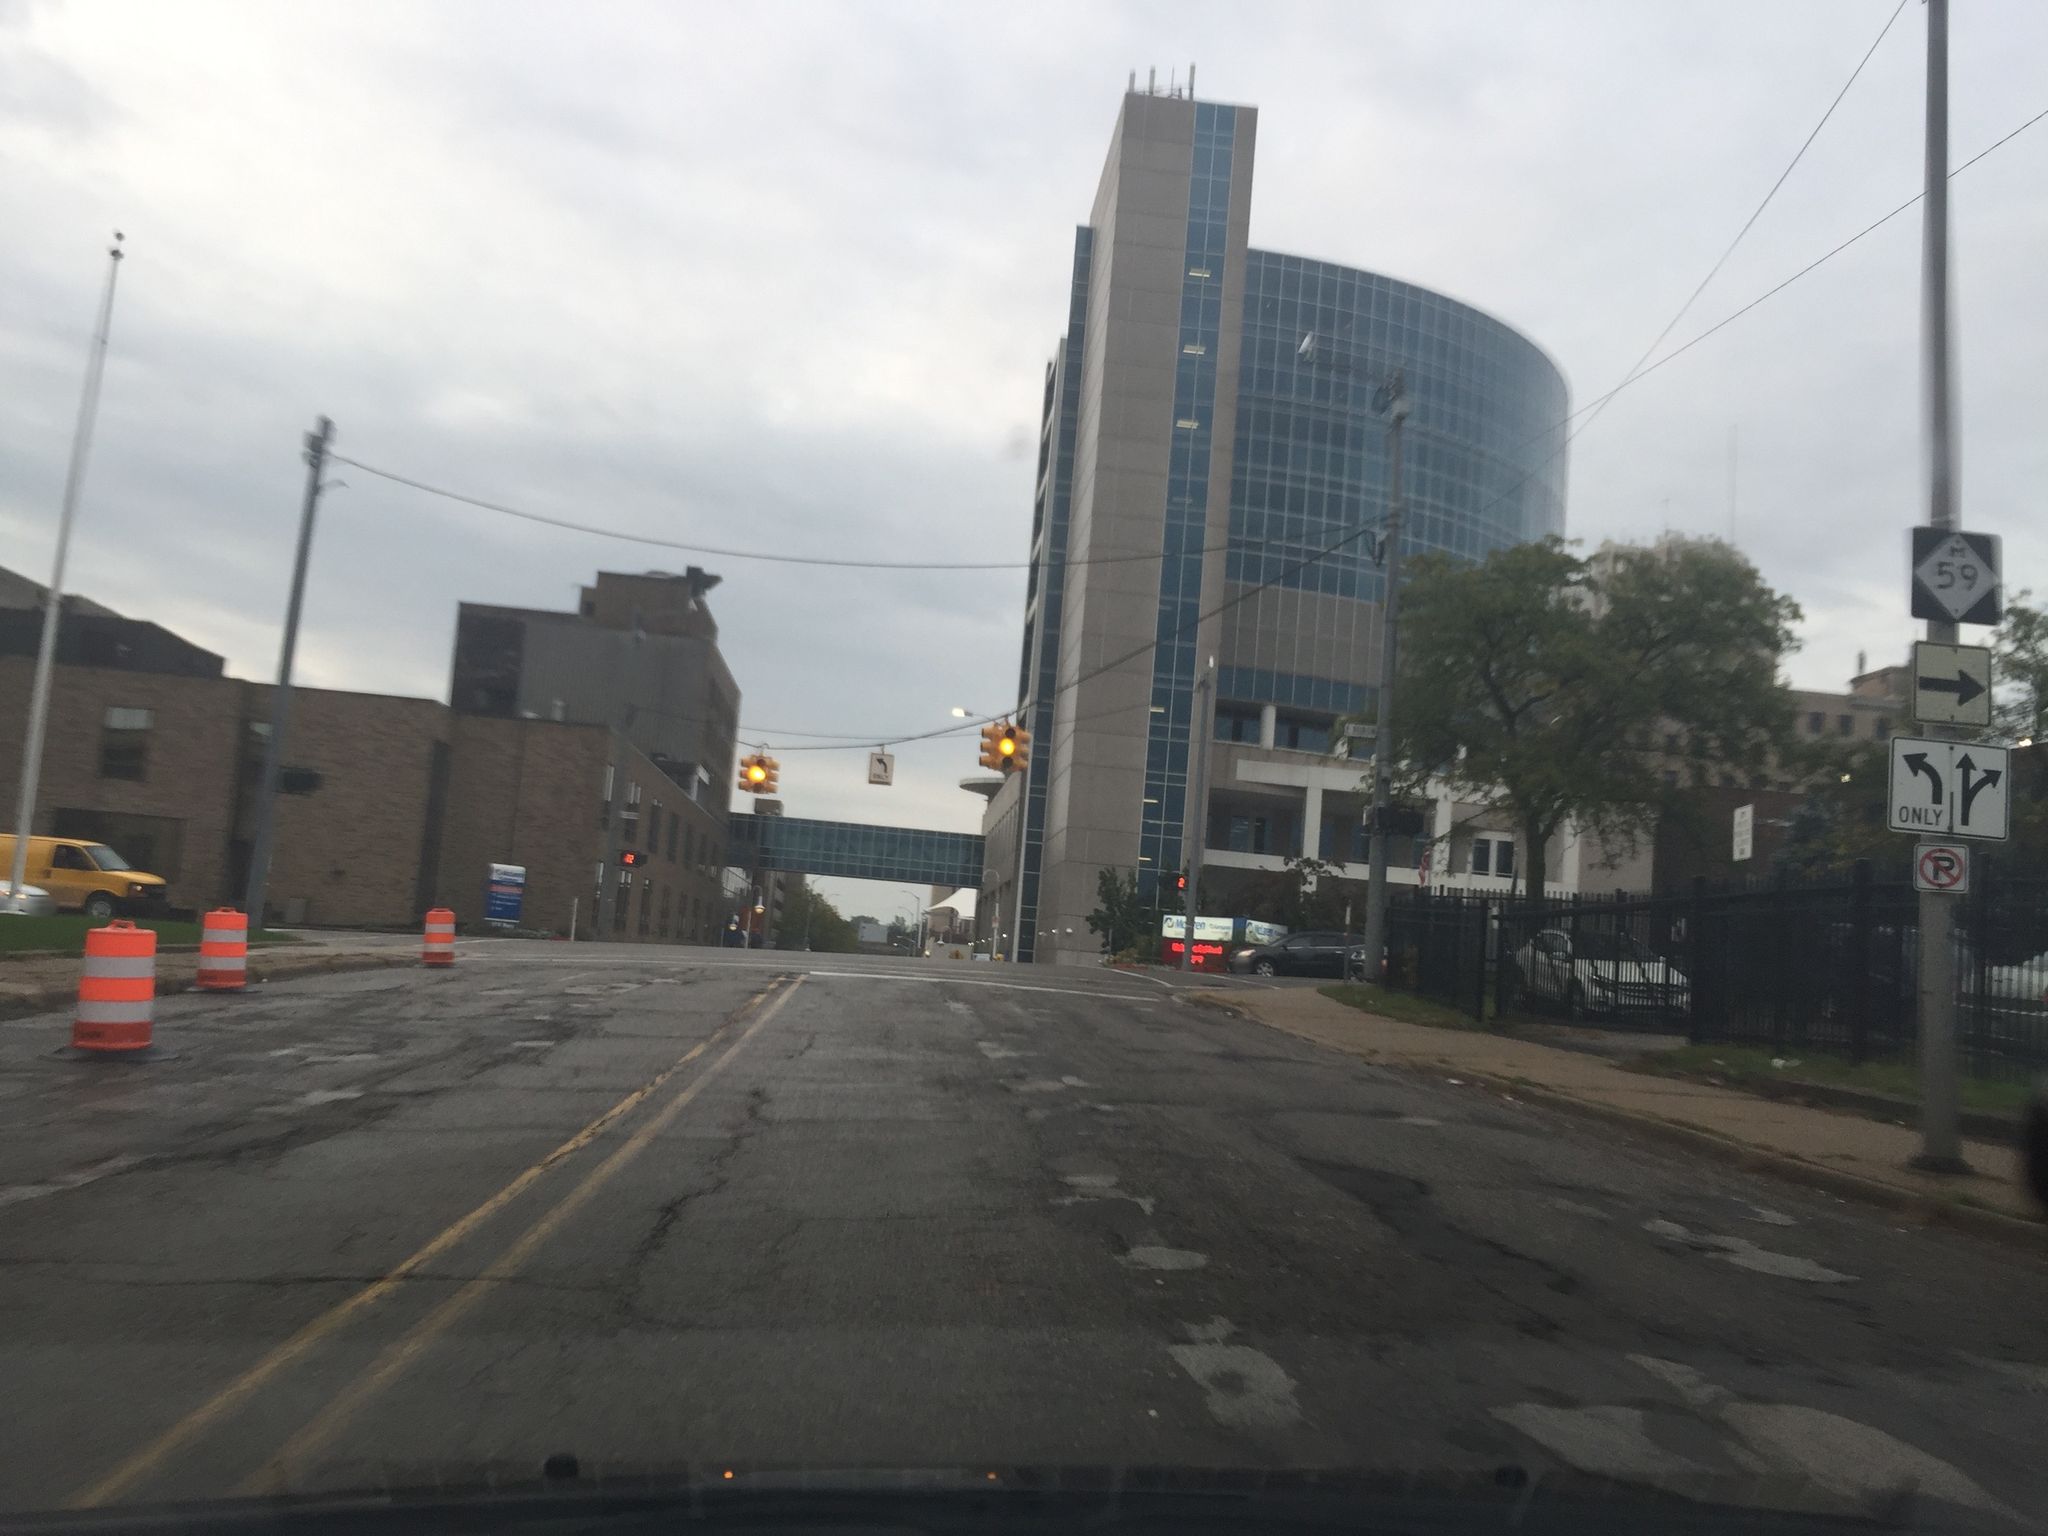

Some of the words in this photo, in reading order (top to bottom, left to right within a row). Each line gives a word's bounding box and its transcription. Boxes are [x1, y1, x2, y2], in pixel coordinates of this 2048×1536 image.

[1950, 546, 1966, 558] M
[1936, 561, 1978, 591] 59
[1899, 806, 1943, 826] ONLY
